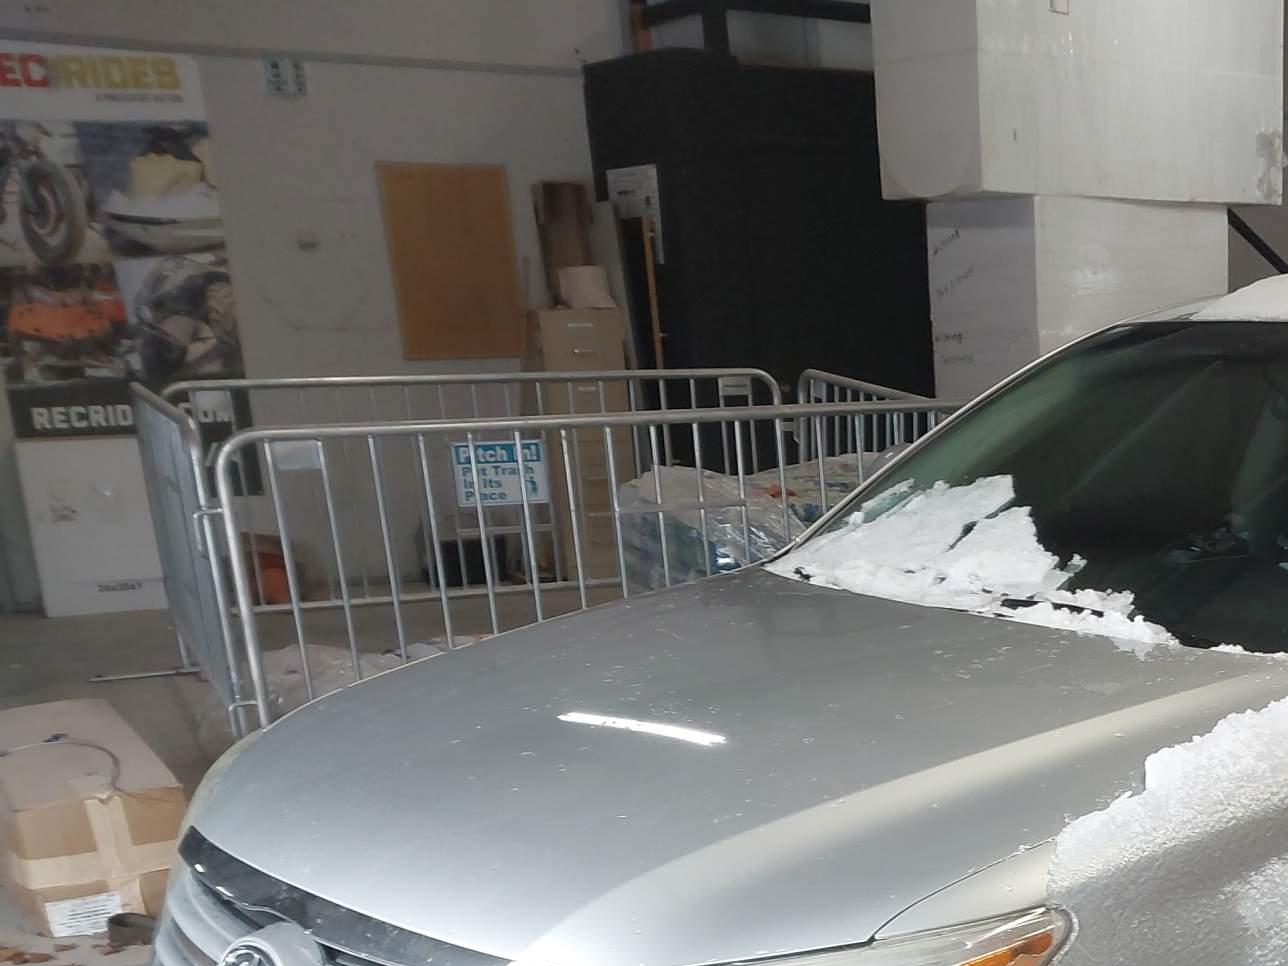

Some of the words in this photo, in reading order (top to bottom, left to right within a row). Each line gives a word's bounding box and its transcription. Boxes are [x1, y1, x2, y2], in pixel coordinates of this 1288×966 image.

[58, 54, 181, 89] RIDES
[459, 445, 508, 462] Ptch
[492, 465, 534, 476] Trah
[465, 491, 507, 501] Pace
